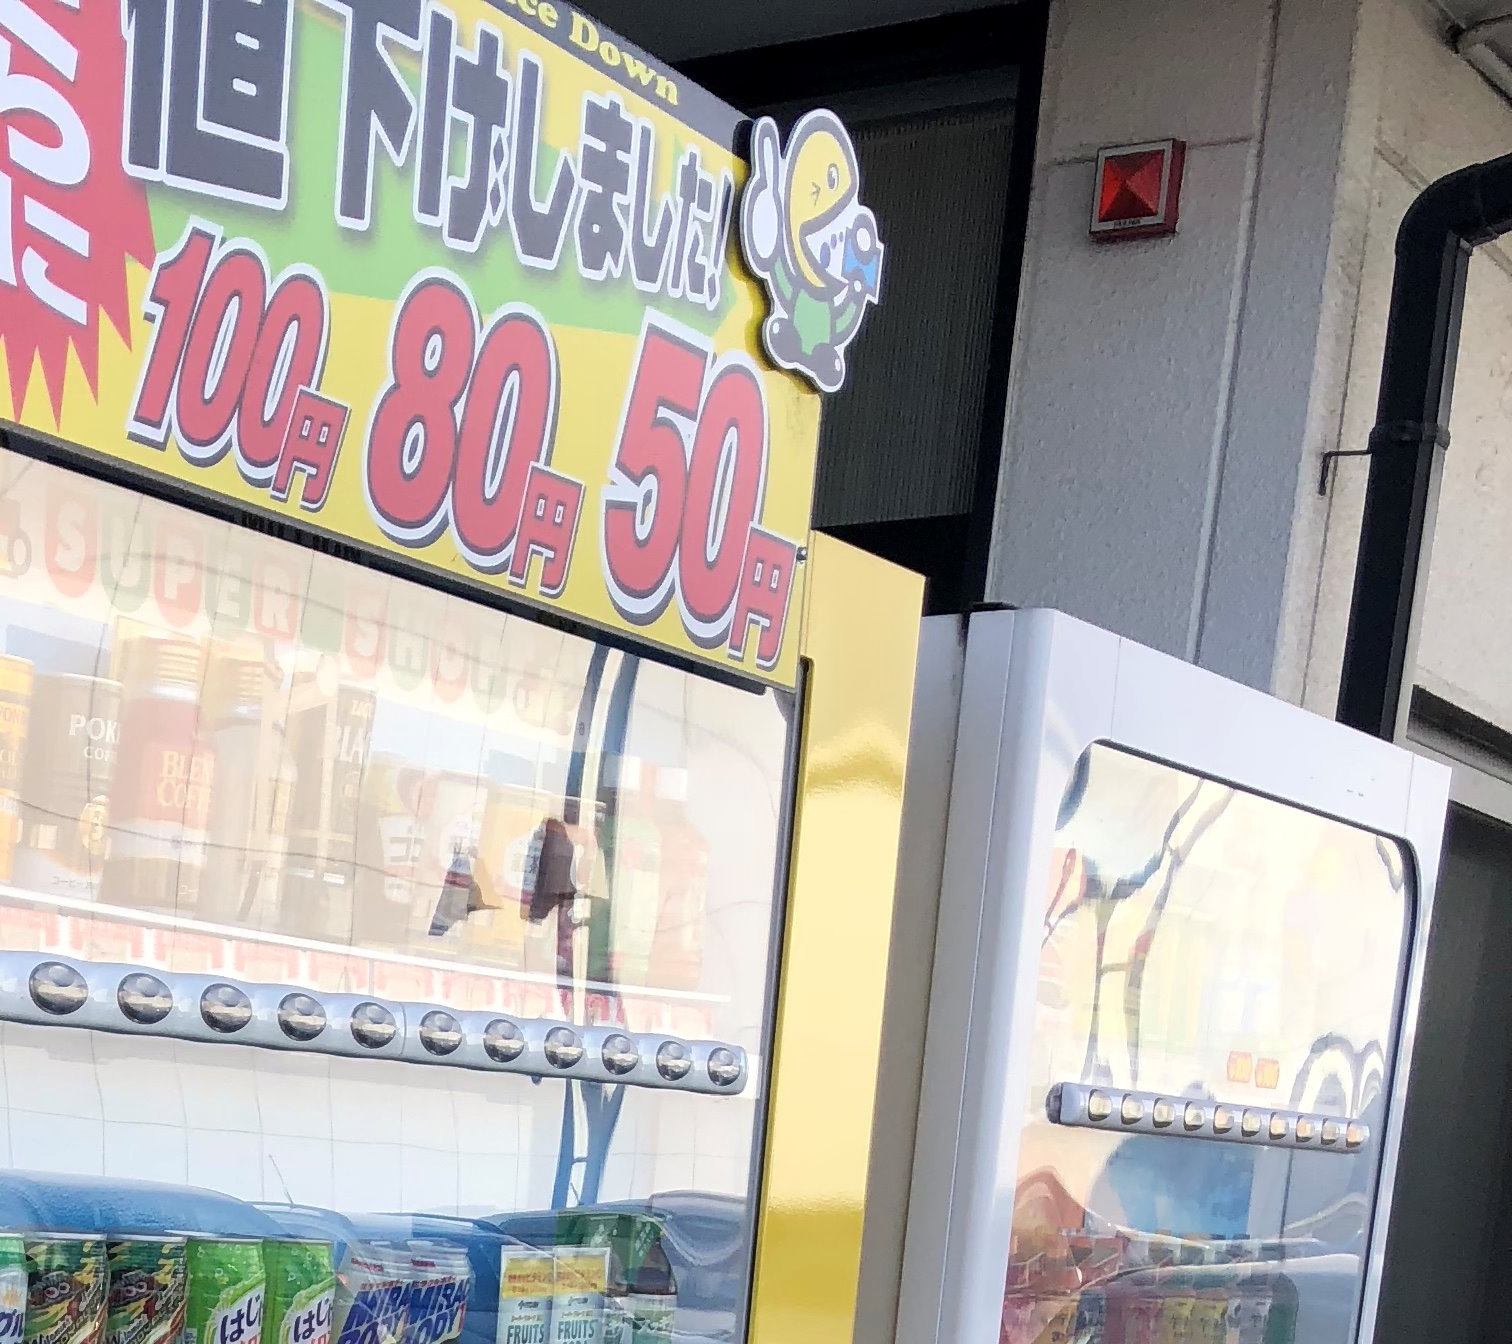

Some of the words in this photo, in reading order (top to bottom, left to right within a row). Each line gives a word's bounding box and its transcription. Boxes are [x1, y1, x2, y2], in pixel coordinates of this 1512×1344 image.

[568, 11, 679, 106] Down
[128, 218, 347, 511] 100円
[364, 266, 584, 599] 80円
[600, 309, 810, 670] 50円
[46, 488, 297, 641] SUPER
[69, 713, 120, 743] POK
[293, 1297, 333, 1343] はじ
[557, 1318, 598, 1341] FRUITS
